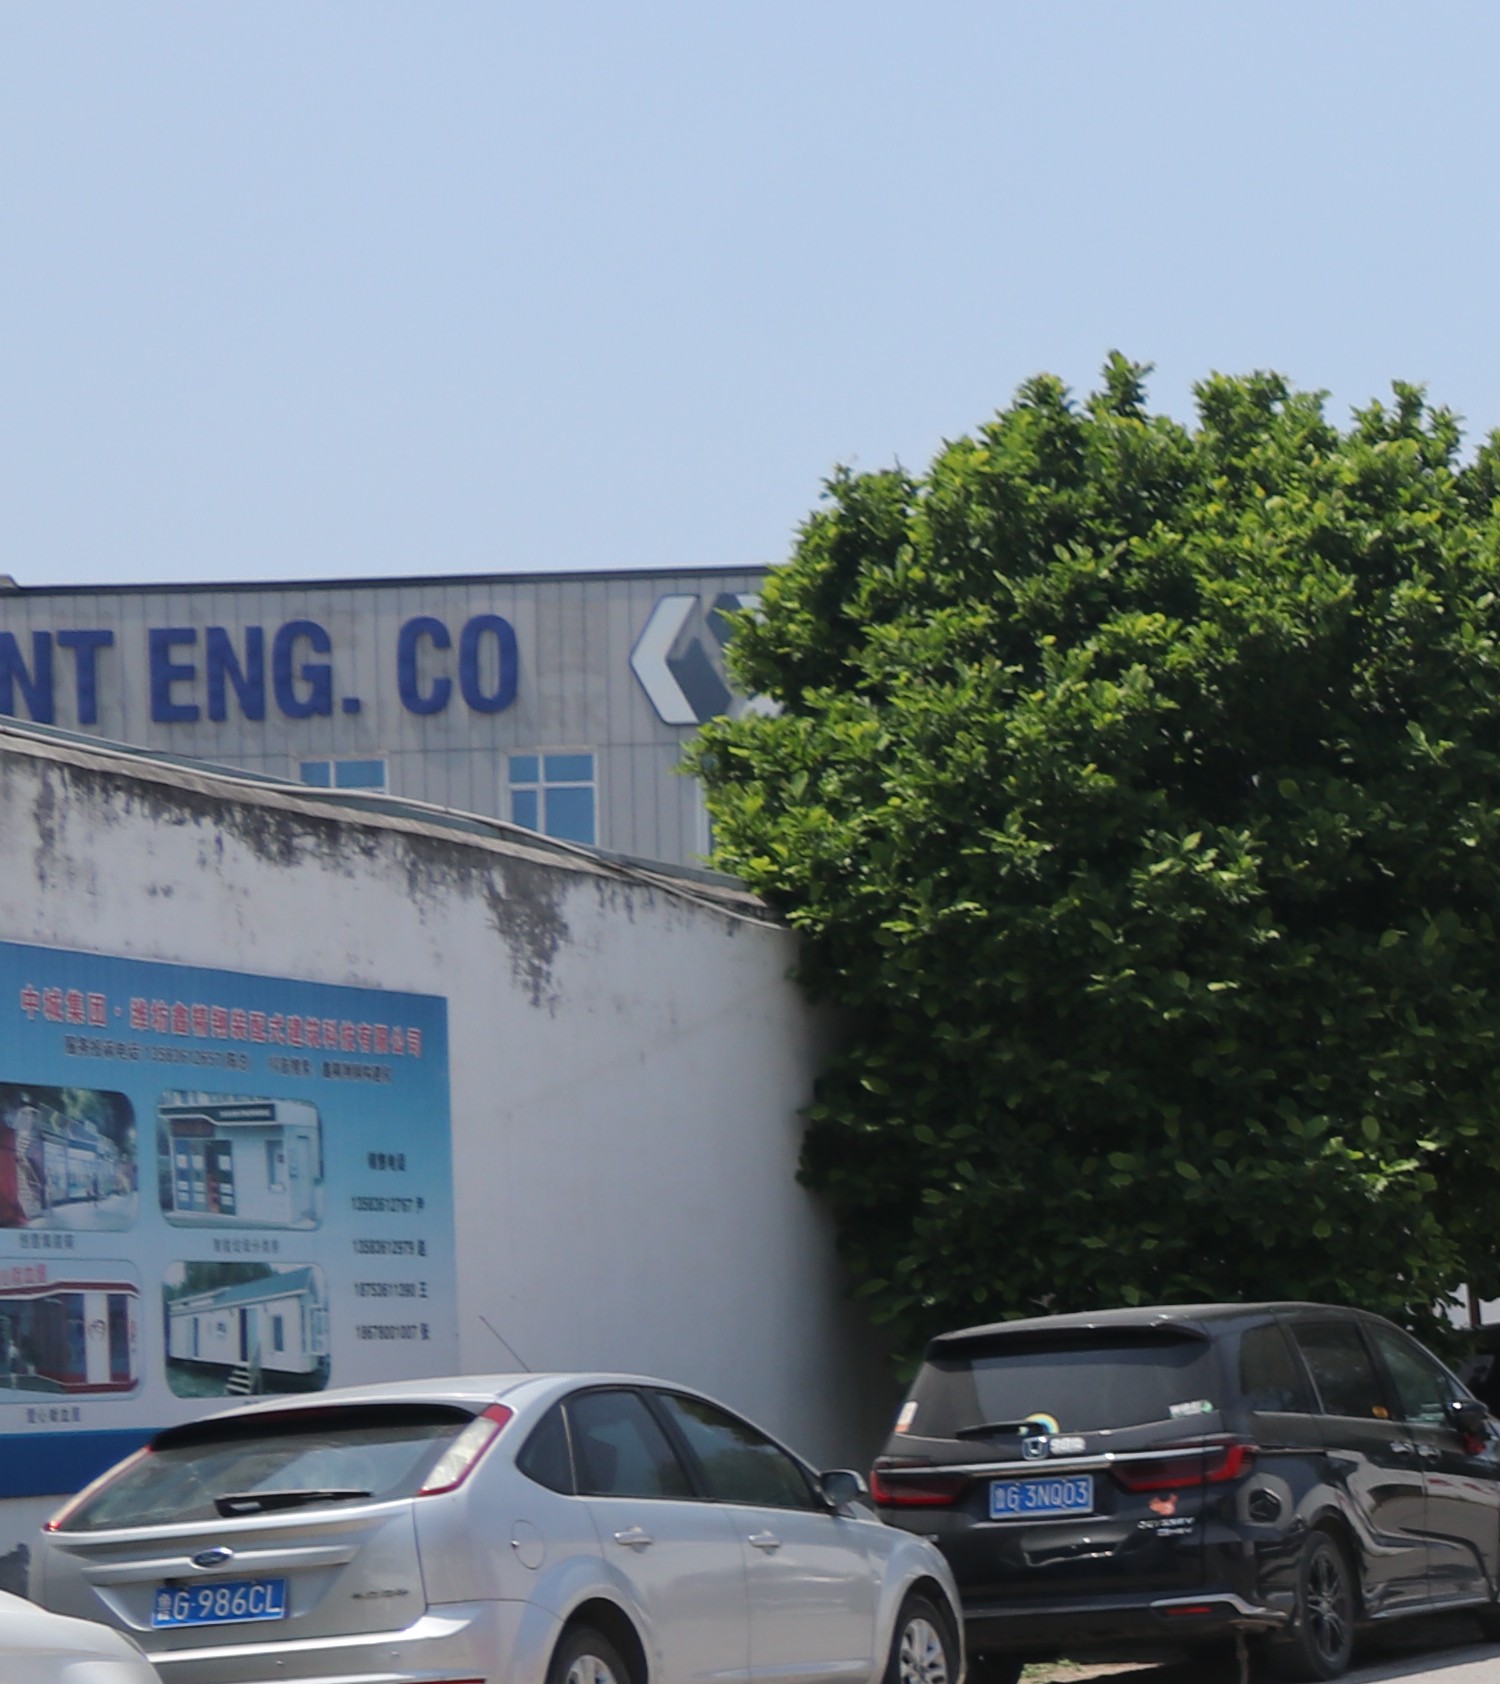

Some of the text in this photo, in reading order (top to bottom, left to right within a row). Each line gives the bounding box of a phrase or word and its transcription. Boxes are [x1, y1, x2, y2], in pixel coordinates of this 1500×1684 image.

[0, 613, 518, 725] NT ENG. CO
